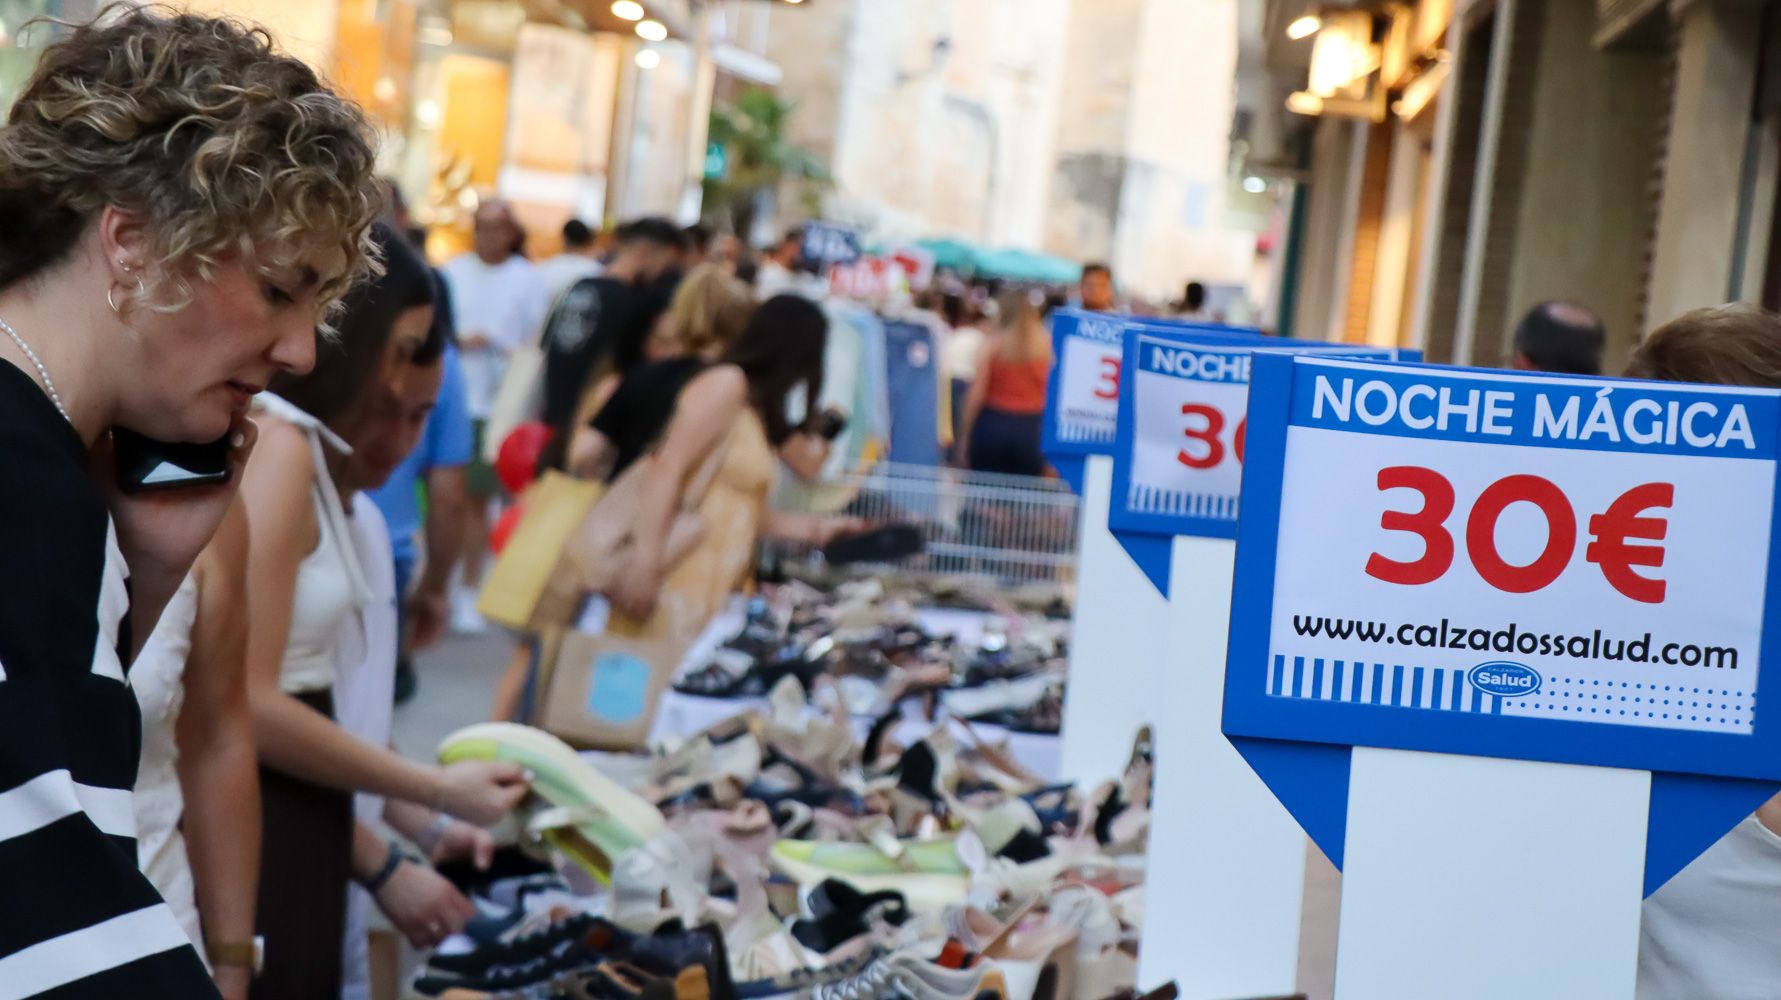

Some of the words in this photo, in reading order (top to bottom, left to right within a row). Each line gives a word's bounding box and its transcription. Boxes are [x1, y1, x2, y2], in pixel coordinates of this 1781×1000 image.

[1178, 403, 1246, 469] 3
[1311, 375, 1515, 436] NOCHE
[1532, 386, 1756, 450] MÁGICA
[1365, 465, 1674, 604] 30€
[1293, 615, 1738, 669] www.calzadossalud.com
[1477, 671, 1533, 687] Salud
